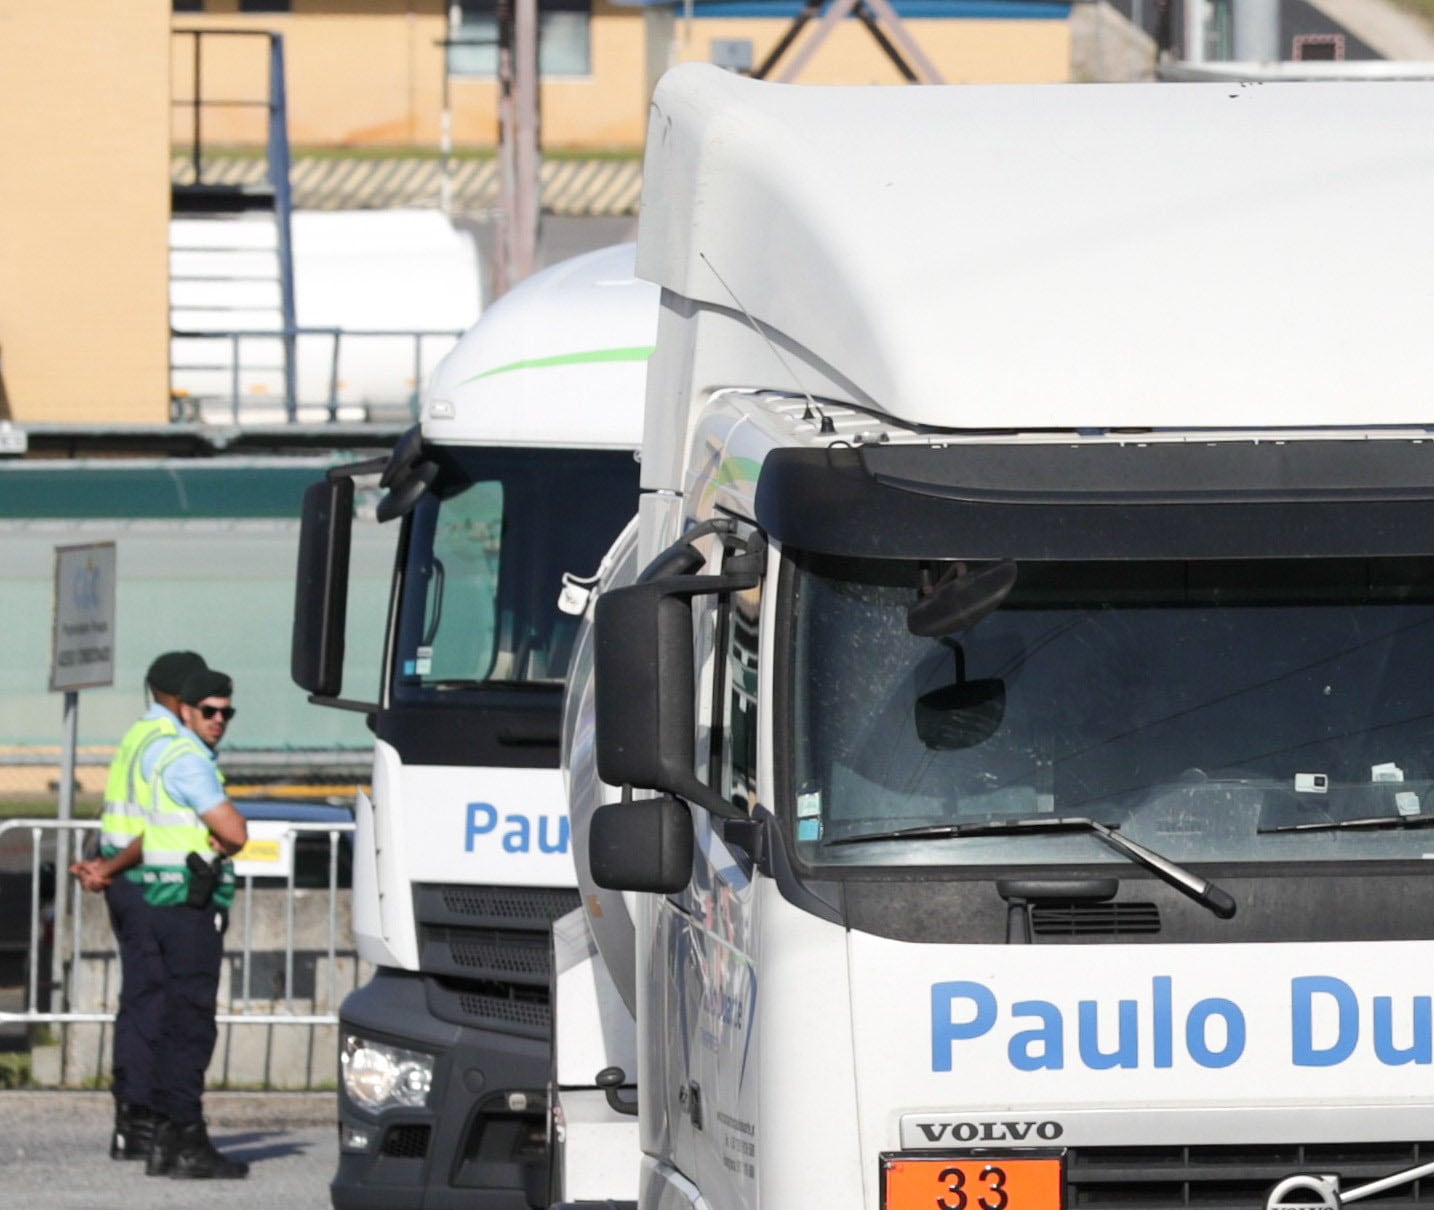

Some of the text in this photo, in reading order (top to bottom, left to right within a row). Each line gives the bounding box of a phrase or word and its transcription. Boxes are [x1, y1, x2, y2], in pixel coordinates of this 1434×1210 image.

[464, 801, 571, 854] Pau
[930, 975, 1248, 1073] Paulo
[915, 1120, 1064, 1143] VOLVO
